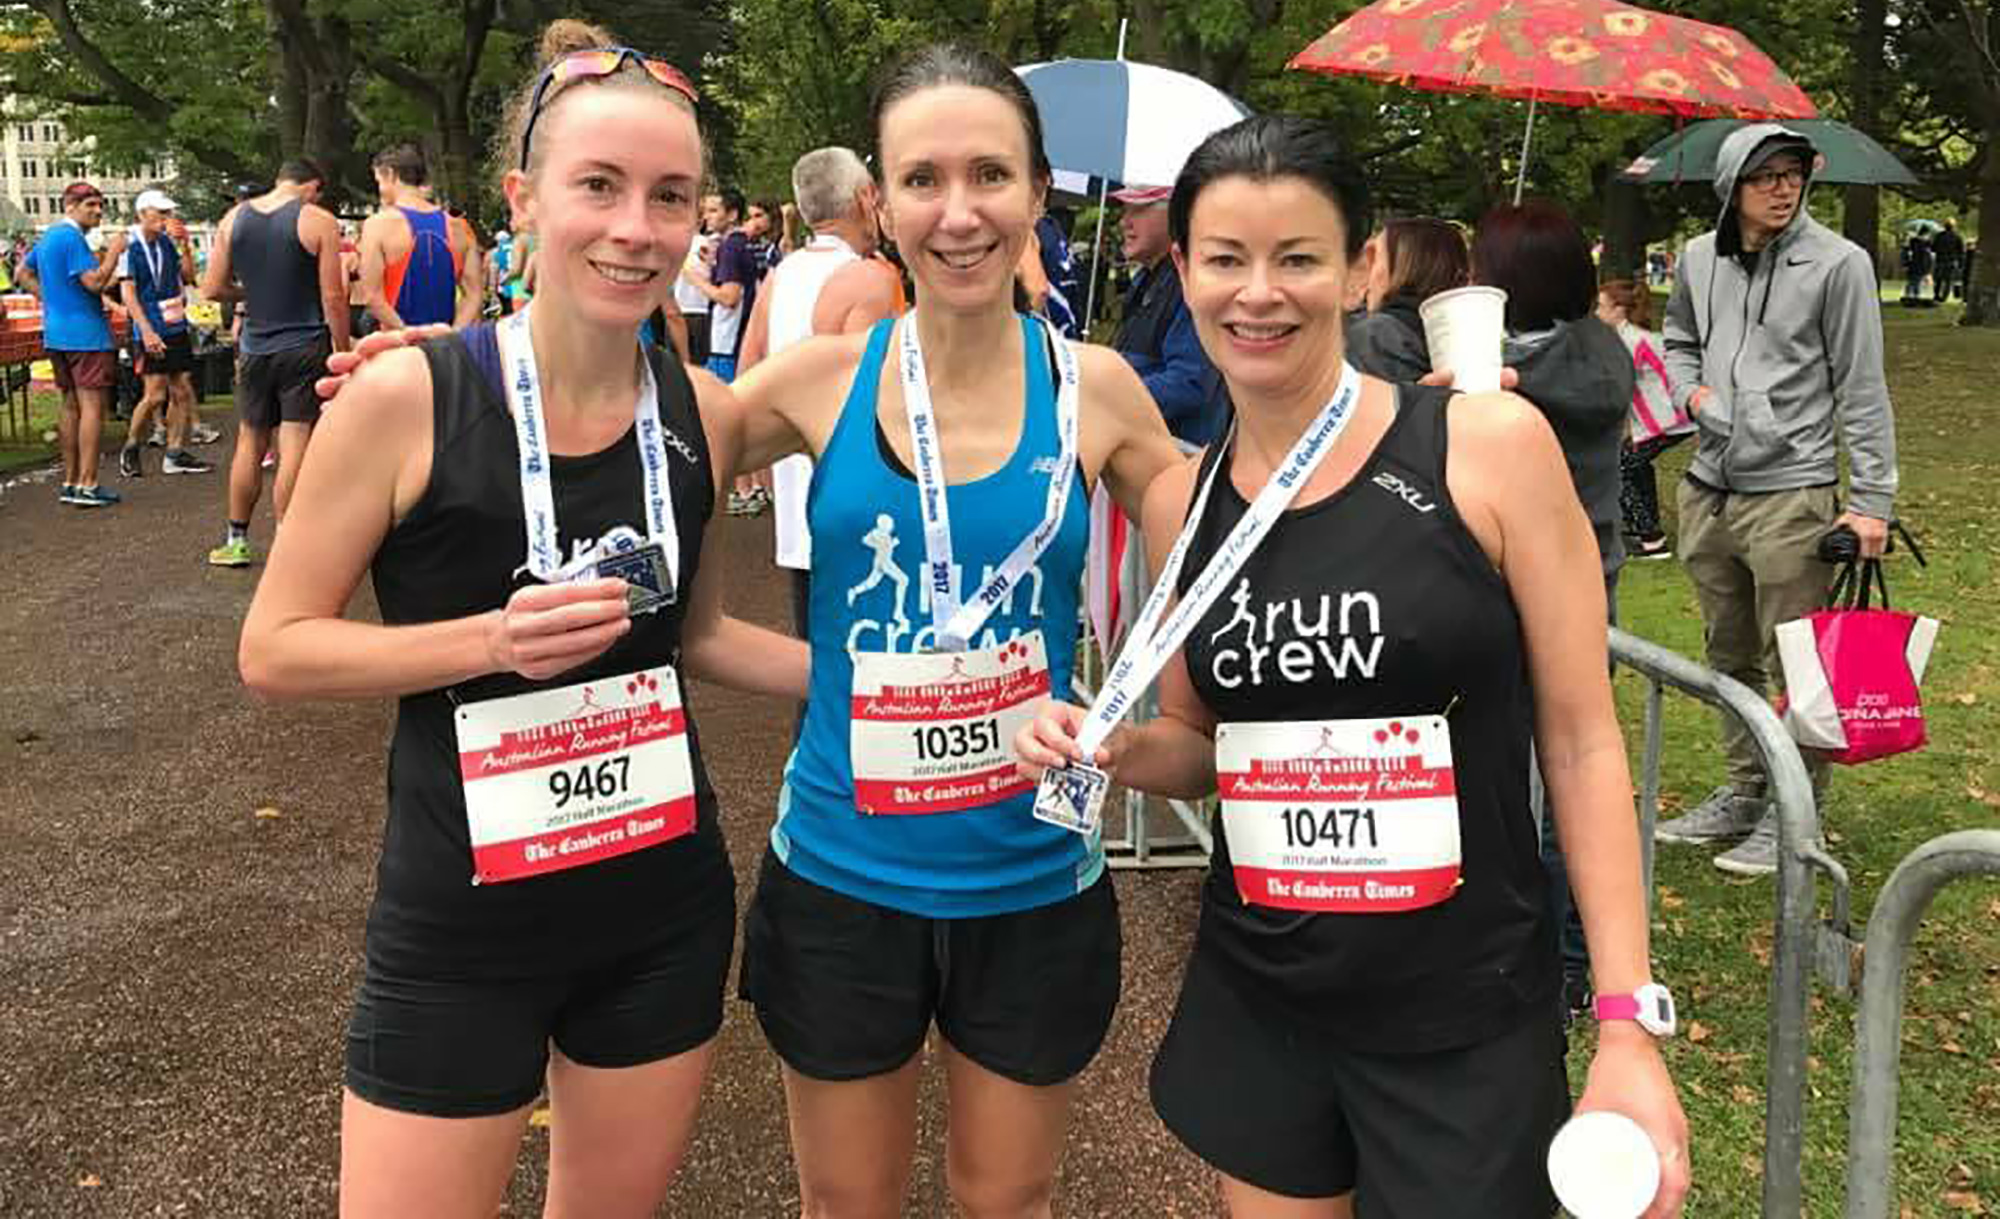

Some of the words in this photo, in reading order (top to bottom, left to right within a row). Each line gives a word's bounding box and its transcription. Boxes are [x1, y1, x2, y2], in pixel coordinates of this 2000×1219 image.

[1275, 466, 1301, 490] The
[1294, 418, 1336, 470] Canberra
[1371, 471, 1437, 513] 2XU
[931, 561, 951, 595] 2017
[979, 574, 1011, 606] 2017
[1265, 590, 1380, 643] run
[1211, 635, 1385, 688] crew
[864, 699, 934, 717] Australian
[936, 694, 996, 716] Running
[1099, 690, 1128, 724] 2017
[481, 747, 566, 769] Australian
[568, 731, 629, 755] Running
[631, 717, 672, 737] Festival
[911, 718, 1000, 761] 10351
[549, 755, 631, 808] 9467
[894, 785, 922, 803] The
[922, 781, 986, 800] Canberra
[1231, 774, 1302, 794] Australian
[1304, 774, 1371, 802] Running
[1375, 771, 1439, 792] Festival
[524, 841, 557, 864] The
[558, 829, 624, 853] Canberra
[627, 816, 666, 838] Times
[1280, 807, 1378, 849] 10471
[1330, 853, 1388, 868] Marathon
[1265, 876, 1291, 898] The
[1291, 877, 1361, 899] Canberra
[1363, 878, 1417, 900] Times
